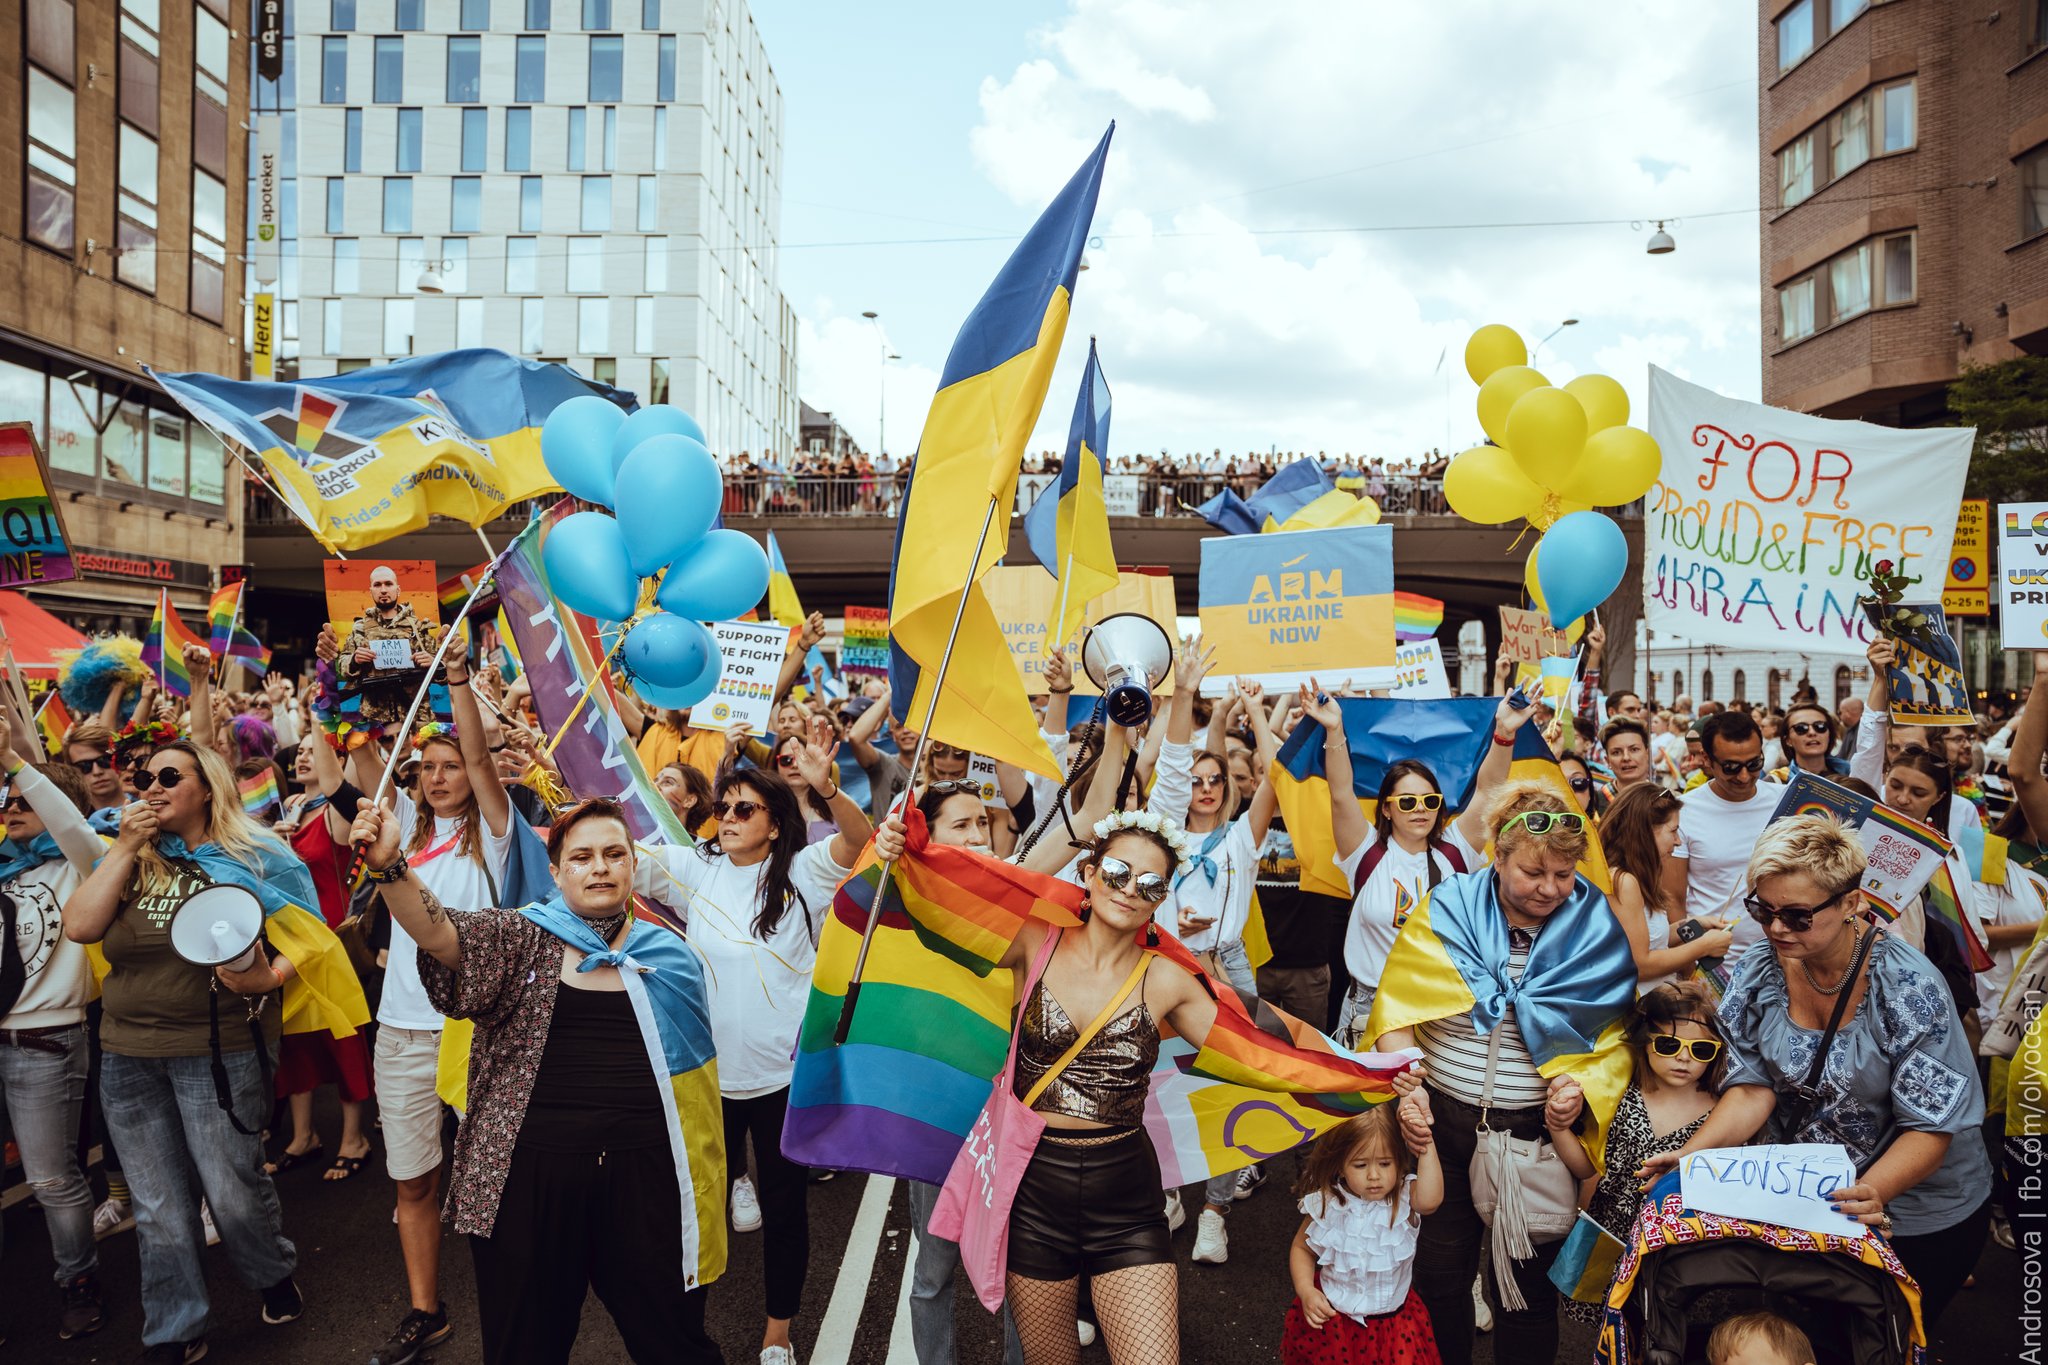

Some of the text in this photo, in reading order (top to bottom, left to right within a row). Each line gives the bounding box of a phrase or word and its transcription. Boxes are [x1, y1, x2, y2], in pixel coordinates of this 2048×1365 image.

[260, 154, 275, 222] apoteket
[254, 304, 270, 355] Hertz
[1692, 424, 1853, 510] FOR
[320, 478, 354, 499] RIDE
[330, 497, 392, 530] Prides
[1962, 504, 1981, 513] och
[1957, 515, 1983, 524] stig-
[1955, 527, 1980, 535] ngs-
[153, 560, 175, 580] XL
[1248, 568, 1343, 603] ARM
[1975, 599, 1985, 608] m
[1248, 602, 1344, 625] UKRAINE
[1502, 610, 1536, 635] War
[717, 629, 782, 646] SUPPORT
[1269, 624, 1321, 645] NOW
[381, 639, 402, 650] ARM
[1007, 641, 1038, 654] ACE
[1504, 634, 1531, 661] My
[383, 657, 403, 665] NOW
[719, 646, 782, 662] HE FIGHT
[726, 664, 755, 676] FOR
[713, 678, 774, 701] EEDOM
[731, 710, 749, 720] STFU
[137, 897, 184, 912] CLOT
[147, 913, 171, 921] ESTAB
